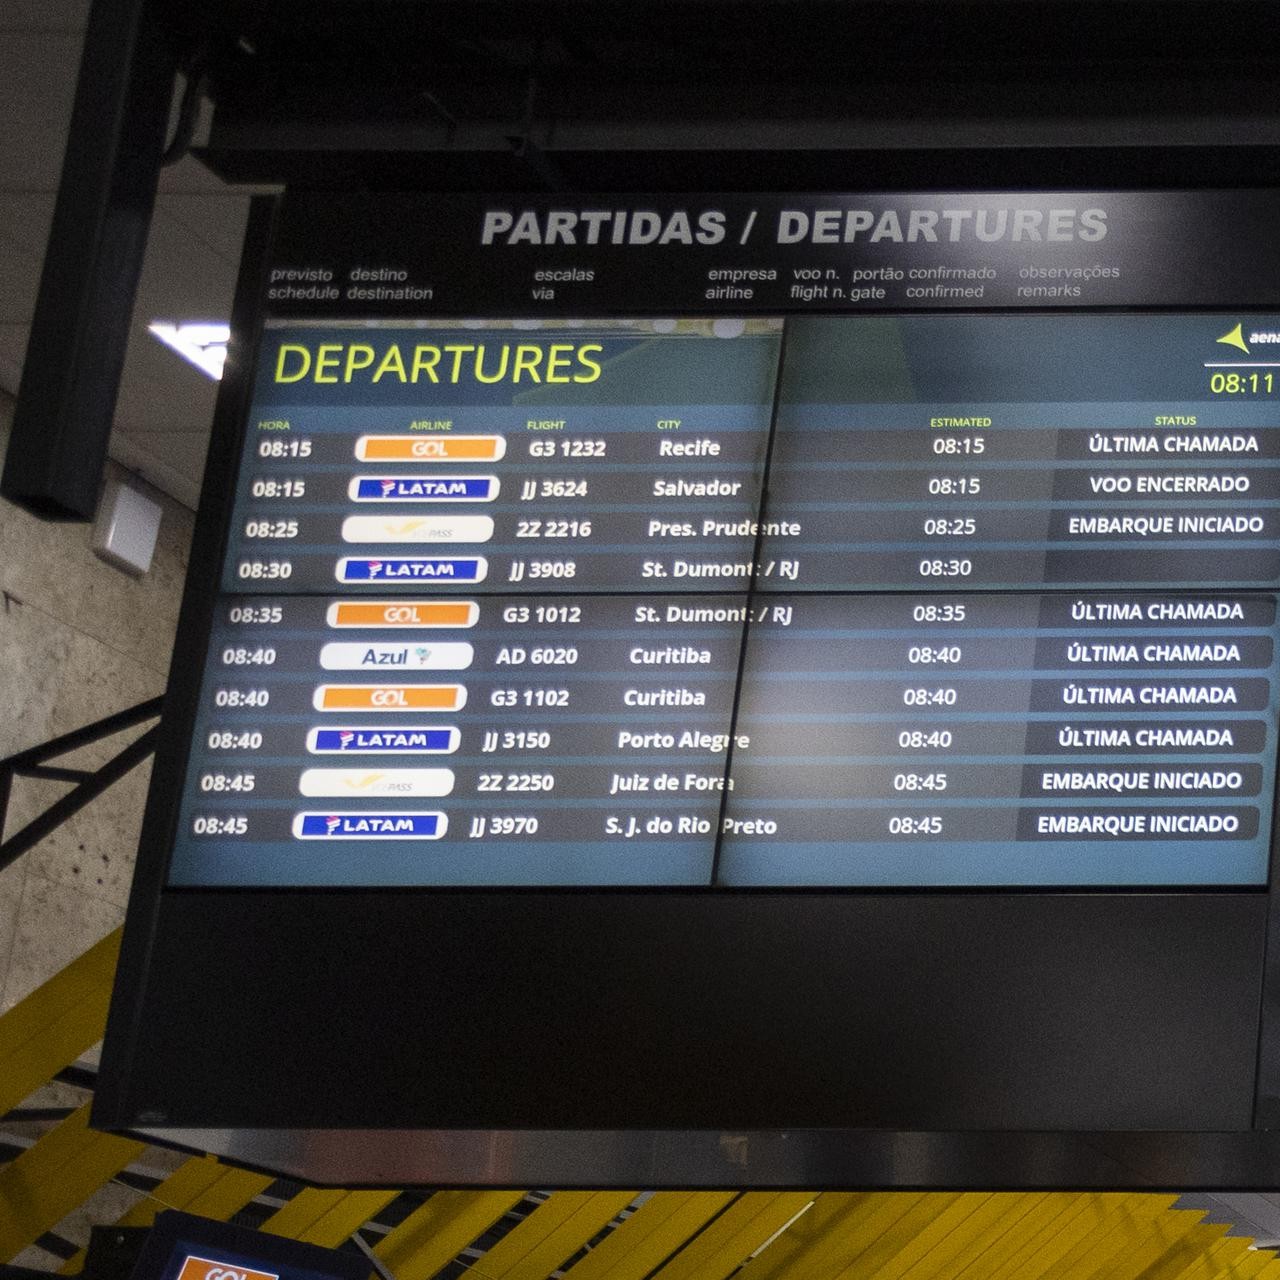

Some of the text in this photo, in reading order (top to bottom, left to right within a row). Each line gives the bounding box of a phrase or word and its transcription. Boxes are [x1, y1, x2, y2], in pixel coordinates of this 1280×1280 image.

[481, 209, 1108, 246] PARTIDAS / DEPARTURES
[271, 265, 1120, 284] previsto destino escalas empresa voo n. portão confirmado observações
[269, 285, 1081, 301] schedule destination via airline flight n. gate confirmed remarks
[274, 345, 603, 383] DEPARTURES
[1210, 374, 1274, 394] 08:11
[258, 416, 1197, 430] HORA AIRLINE FLIGHT CITY ESTIMATED STATUS
[259, 433, 1259, 458] 08:15 GOL G3 1232 Recife 08:15 ÚLTIMA CHAMADA
[223, 642, 1240, 666] 08:40 Azul AD 6020 Curitiba 08:40 ÚLTIMA CHAMADA
[194, 815, 1238, 838] 08:45 LATAM JJ 3970 S. J. do Rio Preto 08:45 EMBARQUE INICIADO
